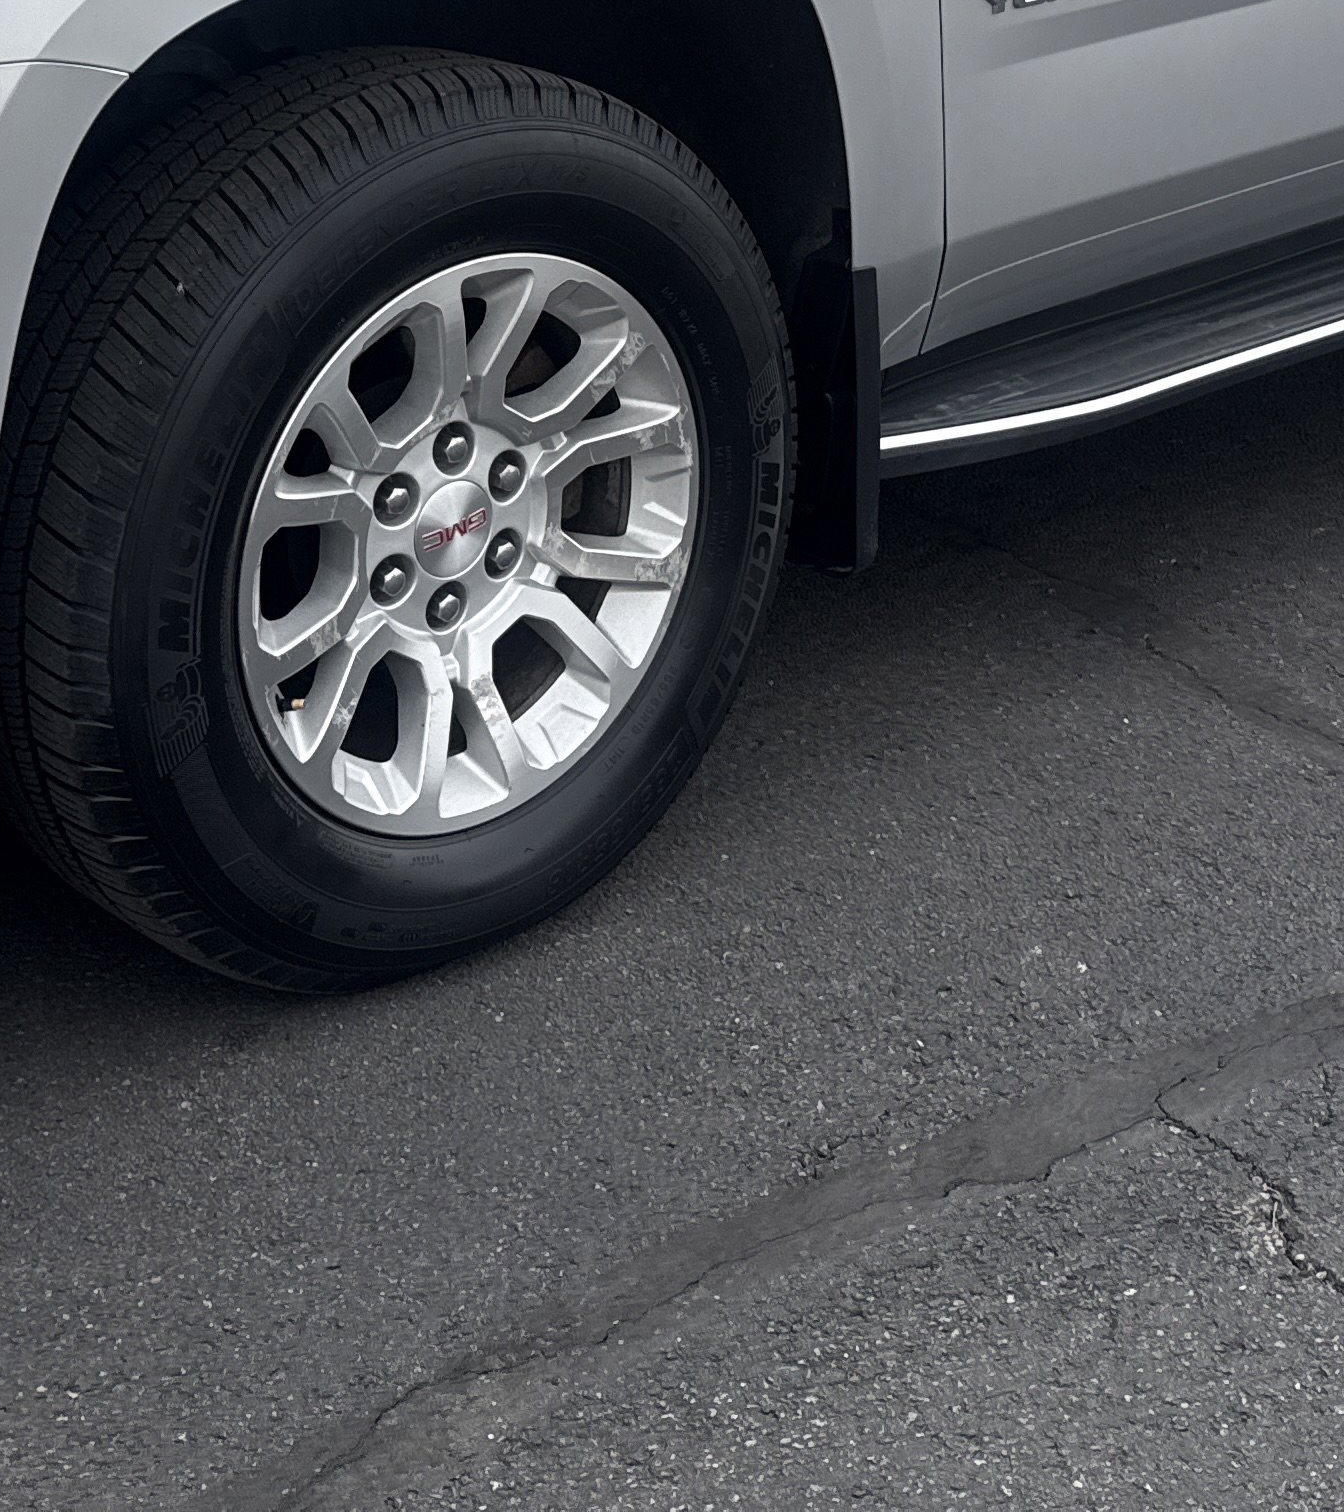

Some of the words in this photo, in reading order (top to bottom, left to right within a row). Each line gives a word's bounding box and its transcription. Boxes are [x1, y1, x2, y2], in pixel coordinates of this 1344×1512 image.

[157, 324, 281, 652] MICHELIN
[421, 507, 487, 553] GMC
[696, 462, 780, 724] MICHELIN
